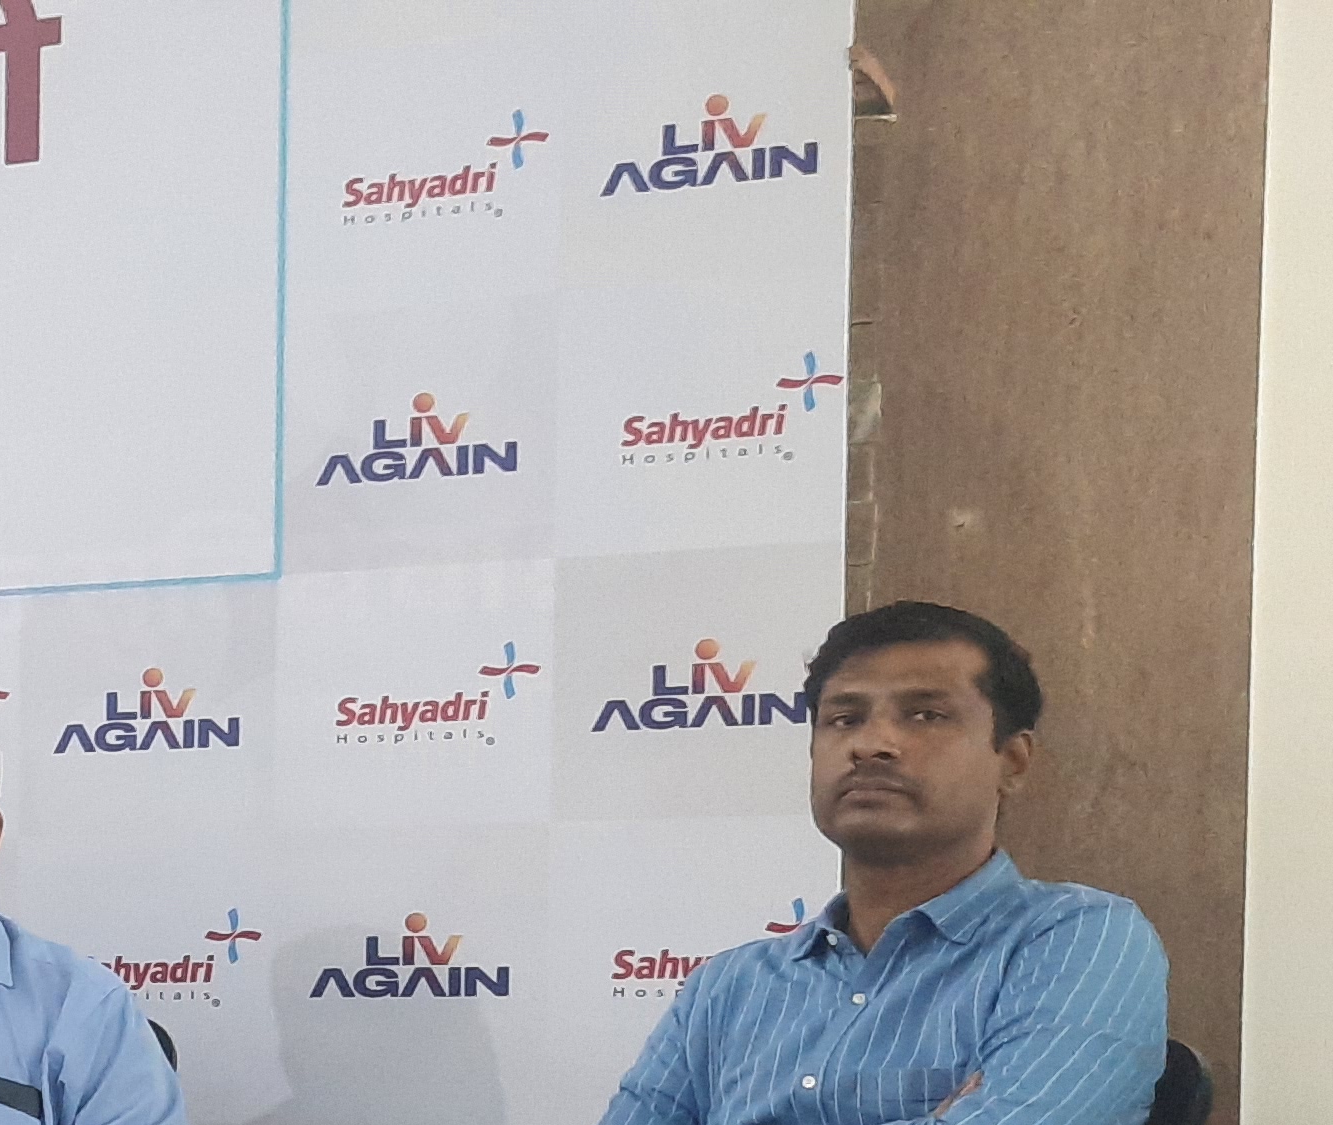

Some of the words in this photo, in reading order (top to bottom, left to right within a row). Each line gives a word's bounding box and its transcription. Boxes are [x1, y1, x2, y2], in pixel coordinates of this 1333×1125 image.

[662, 95, 766, 155] LIV
[342, 162, 498, 209] Sahyadri
[600, 141, 819, 197] AGAIN
[342, 201, 493, 225] Hospitals
[373, 393, 469, 449] LIV
[621, 404, 787, 452] Sahyadri
[316, 441, 518, 486] AGAIN
[621, 445, 782, 465] Hospitals
[652, 638, 757, 696] LIV
[106, 668, 196, 719] LIV
[336, 691, 490, 730] Sahyadri
[590, 692, 808, 732] AGAIN
[54, 717, 240, 755] AGAIN
[336, 730, 485, 746] Hospitals
[366, 913, 462, 966] LIV
[101, 955, 215, 990] hyadri
[309, 966, 509, 998] AGAIN
[145, 990, 211, 1000] itals
